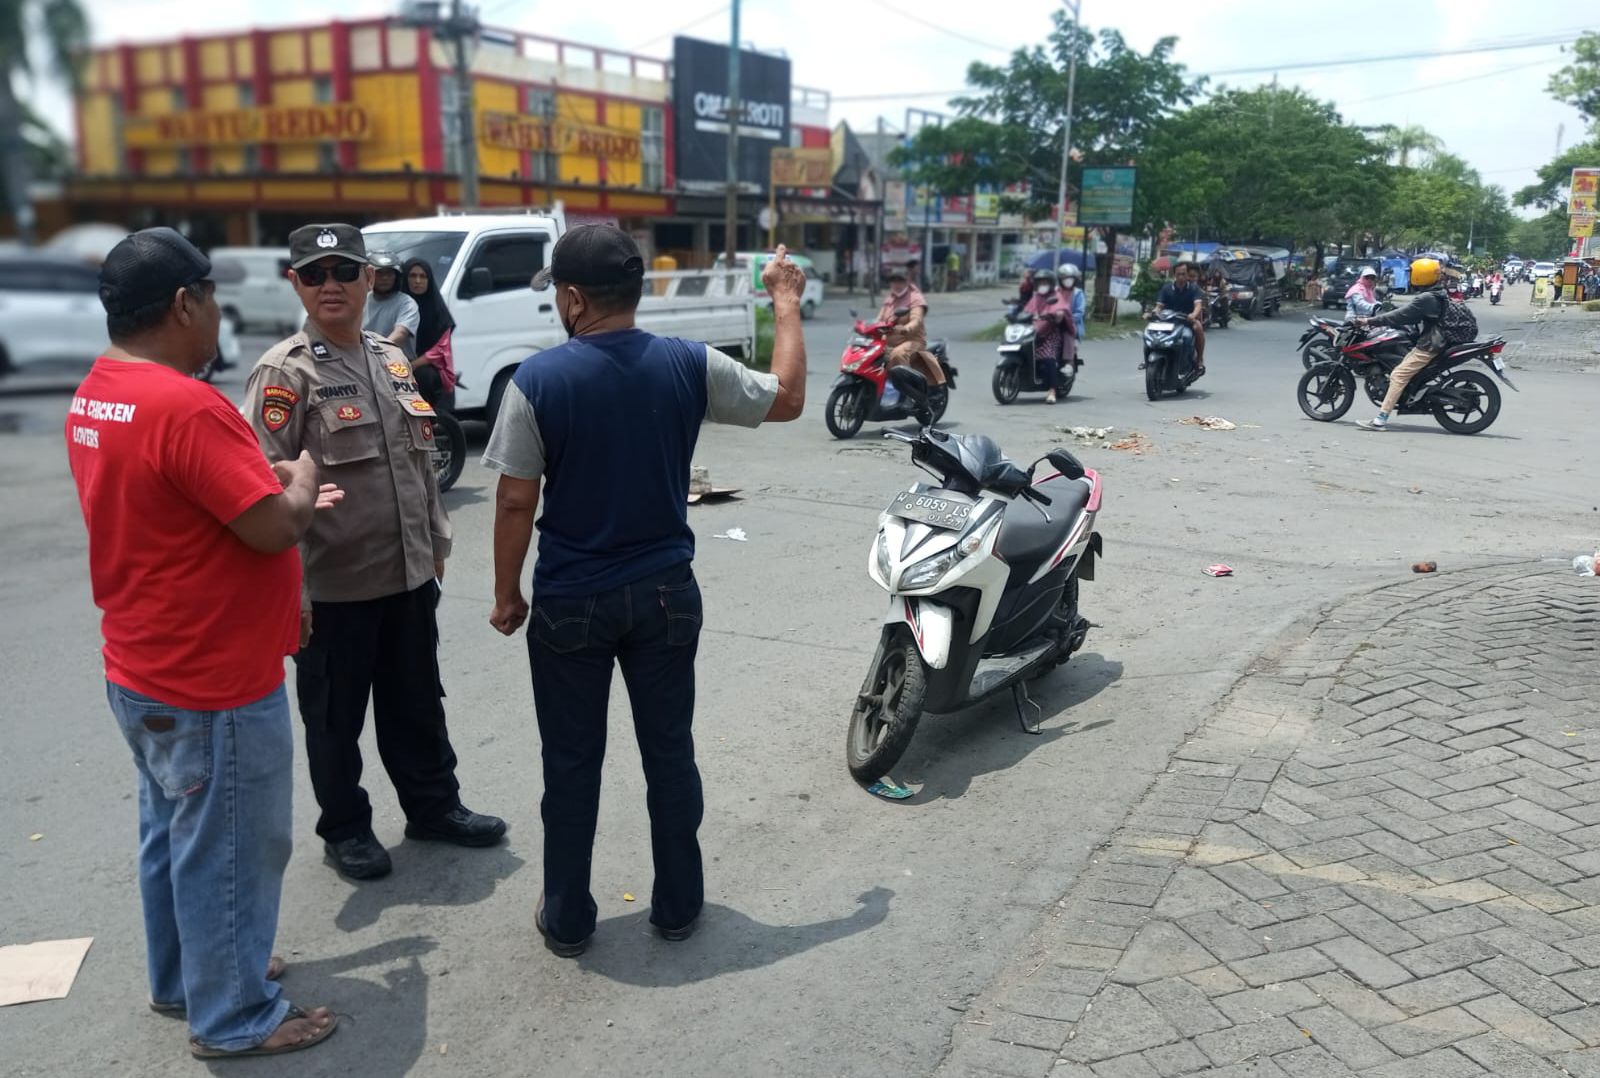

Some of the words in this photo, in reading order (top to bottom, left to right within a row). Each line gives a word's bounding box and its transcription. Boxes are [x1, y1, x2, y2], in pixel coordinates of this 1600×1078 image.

[264, 106, 368, 139] REDJO
[747, 101, 783, 127] ROTI
[87, 400, 136, 422] CHICKEN
[73, 426, 98, 449] LOVERS
[916, 497, 947, 511] 6059
[952, 505, 970, 518] LS
